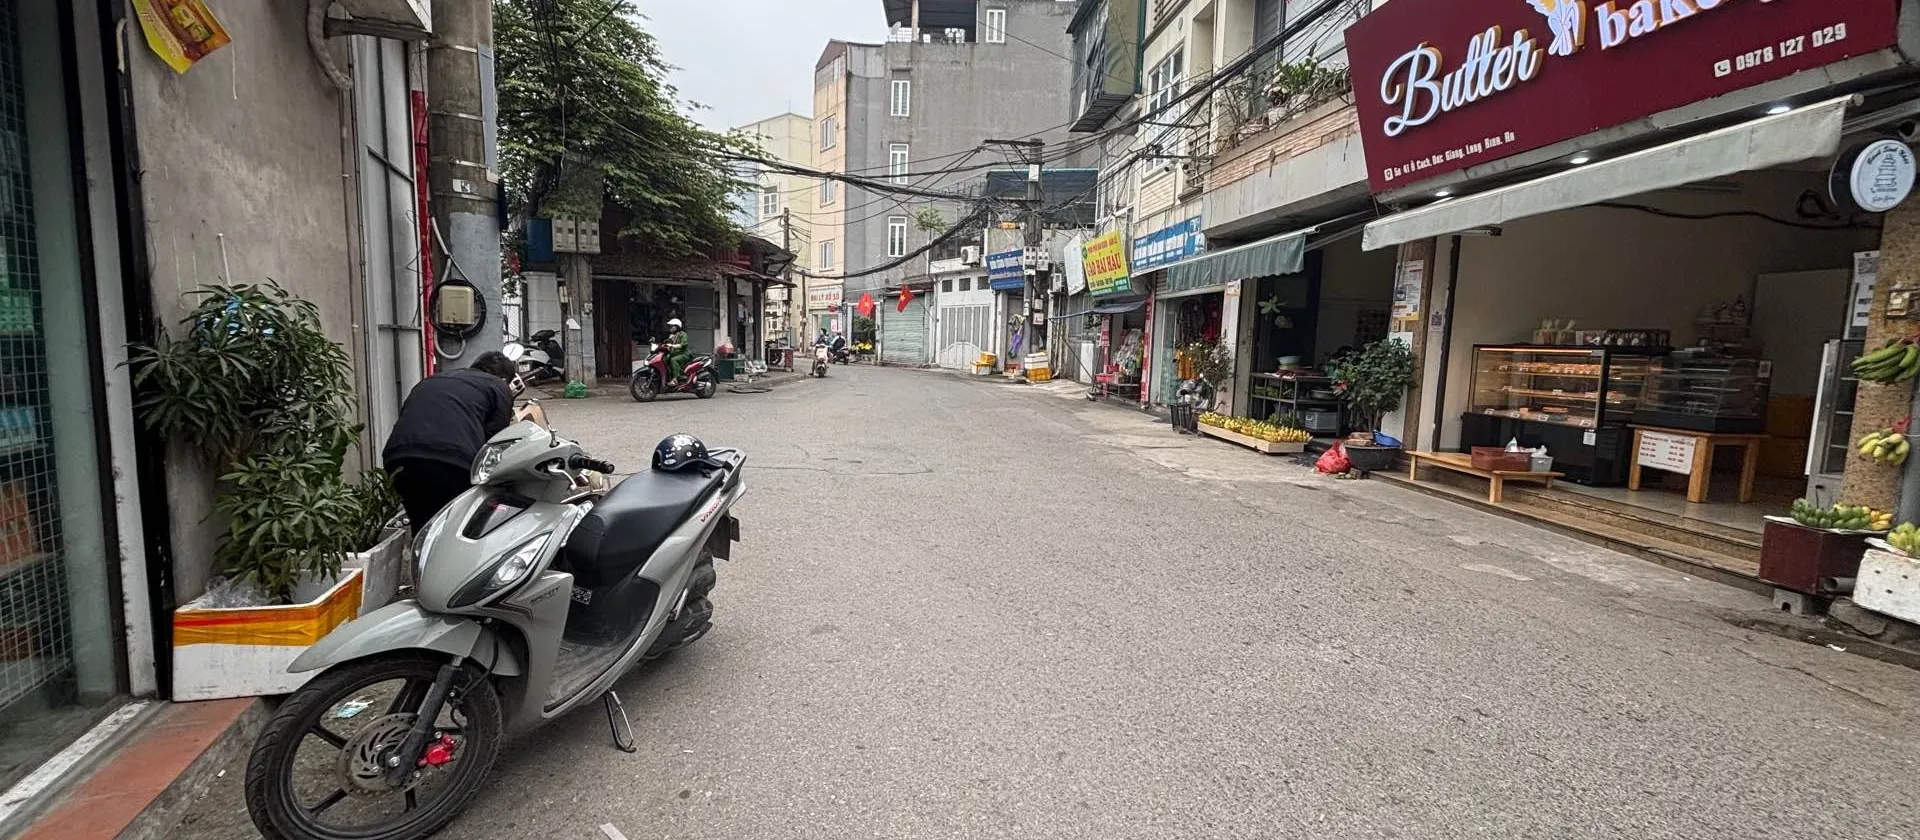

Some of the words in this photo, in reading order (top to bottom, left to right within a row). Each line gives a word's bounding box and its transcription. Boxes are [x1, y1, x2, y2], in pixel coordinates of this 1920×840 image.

[1381, 25, 1543, 137] Butter
[1736, 46, 1774, 71] 0978
[1780, 36, 1805, 57] 127
[1812, 23, 1847, 48] 029
